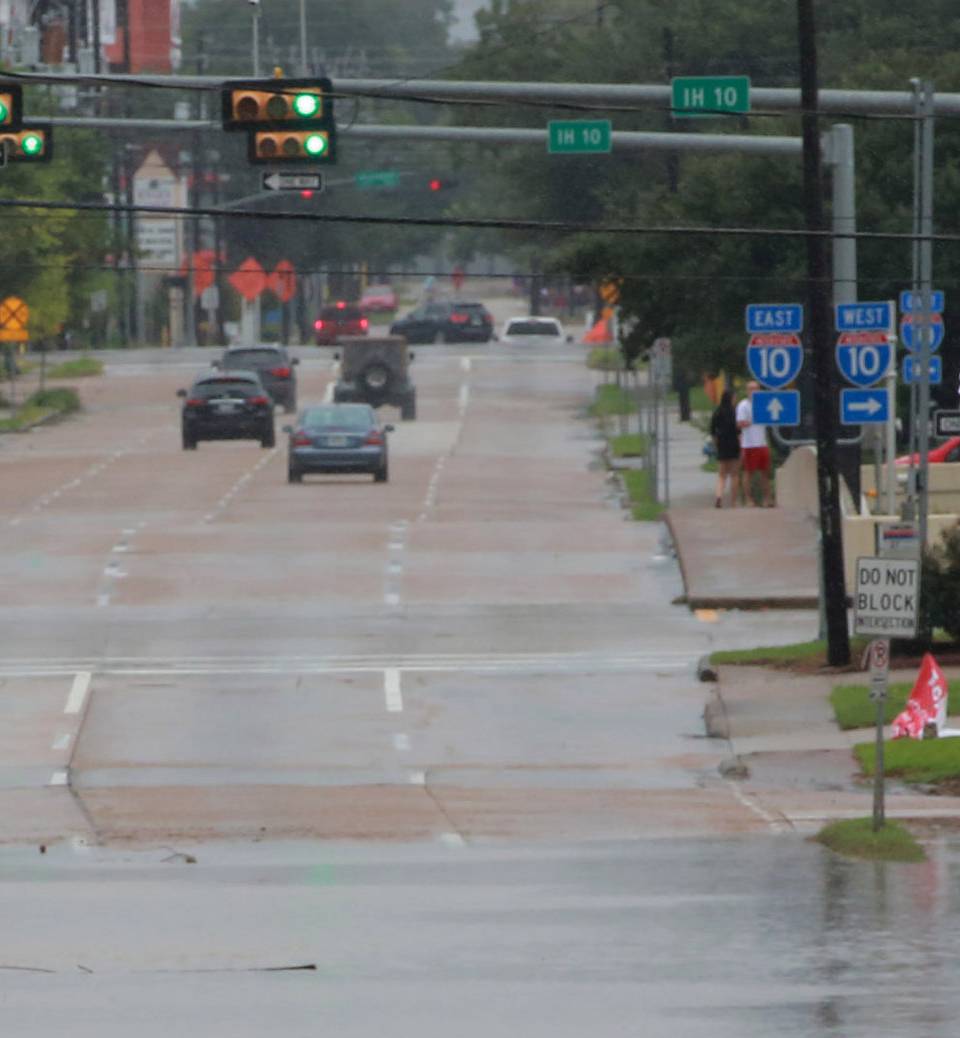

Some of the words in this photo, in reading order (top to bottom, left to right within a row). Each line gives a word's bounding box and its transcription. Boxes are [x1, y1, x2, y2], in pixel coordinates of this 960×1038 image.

[684, 87, 704, 106] IH
[715, 87, 738, 106] 10
[557, 128, 575, 145] IH
[583, 127, 601, 145] 10
[754, 310, 794, 327] EAST
[842, 307, 884, 326] WEST
[758, 347, 791, 379] 10
[847, 346, 881, 377] 10
[860, 568, 880, 586] DO
[885, 568, 916, 587] NOT
[857, 592, 914, 611] BLOCK
